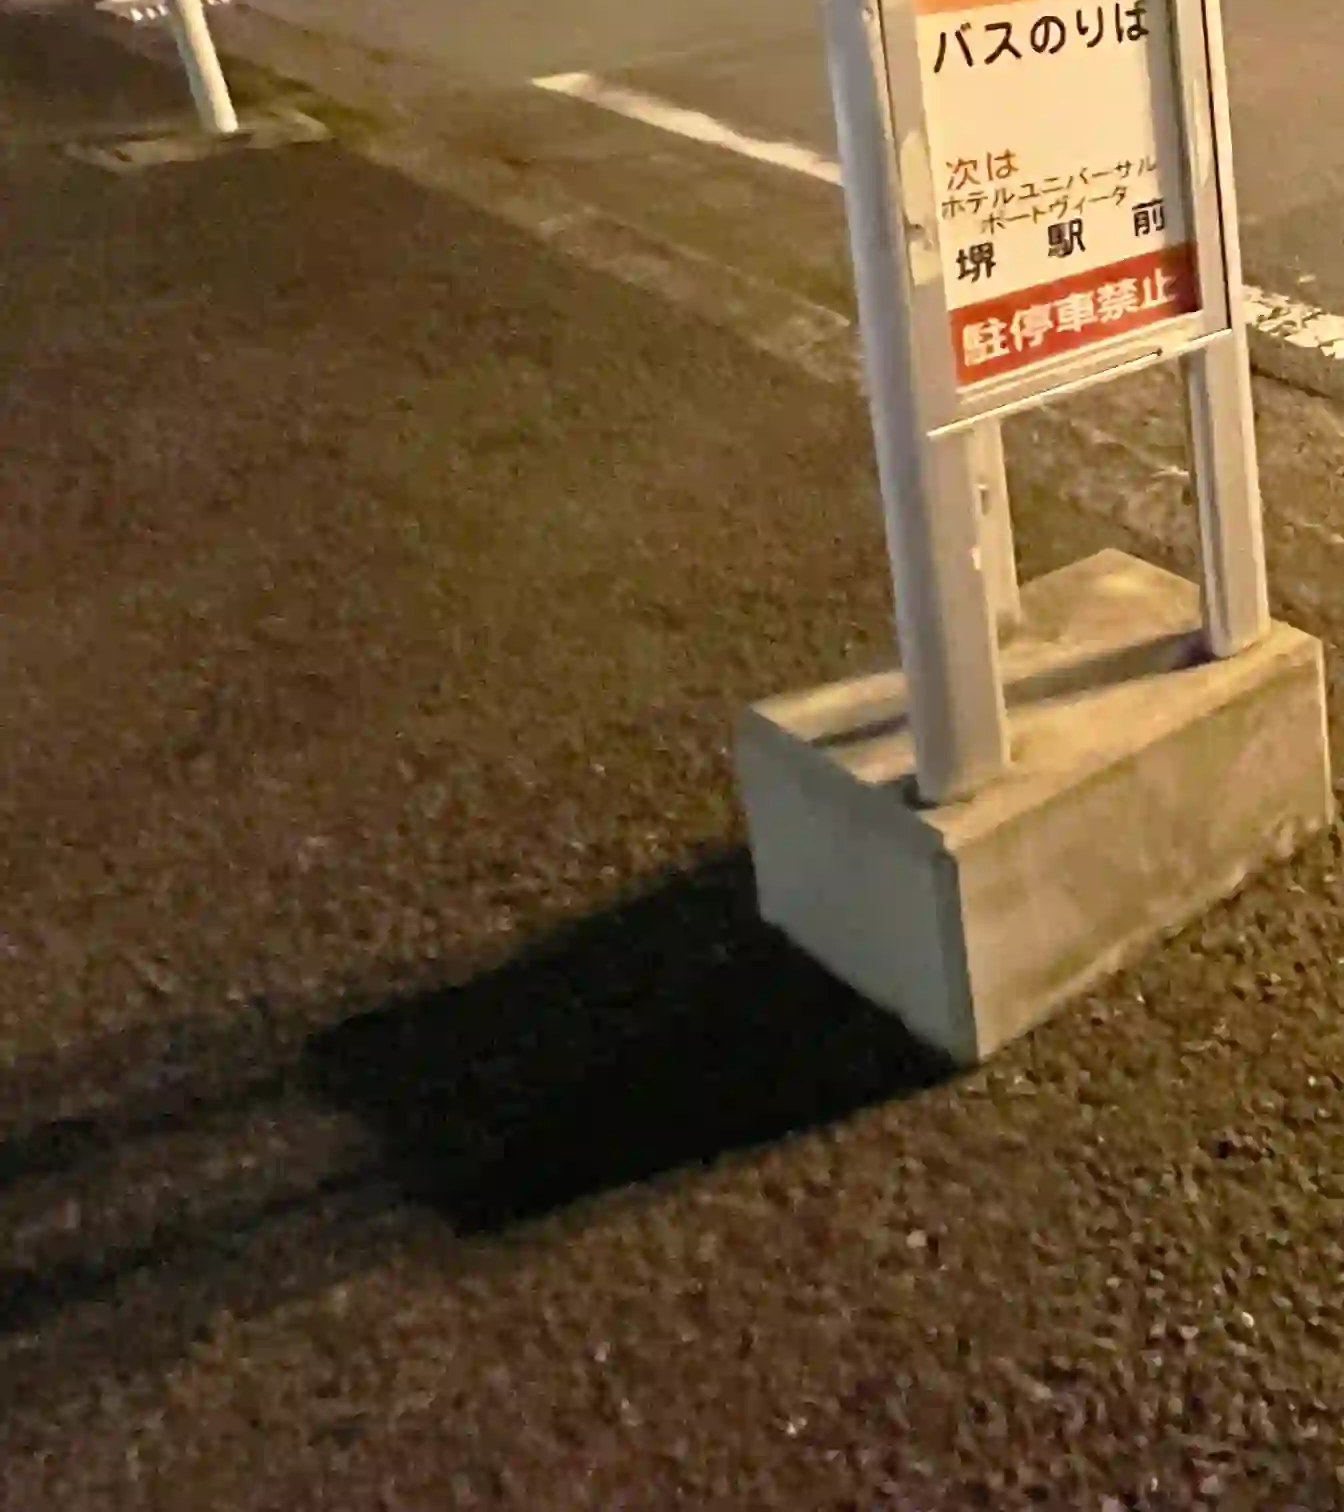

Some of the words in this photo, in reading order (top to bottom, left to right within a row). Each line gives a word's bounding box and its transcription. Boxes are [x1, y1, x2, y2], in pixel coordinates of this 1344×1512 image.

[941, 154, 1157, 220] ホテルユニバーサル
[945, 148, 1019, 192] 次は
[962, 267, 1177, 367] 駐停車禁止
